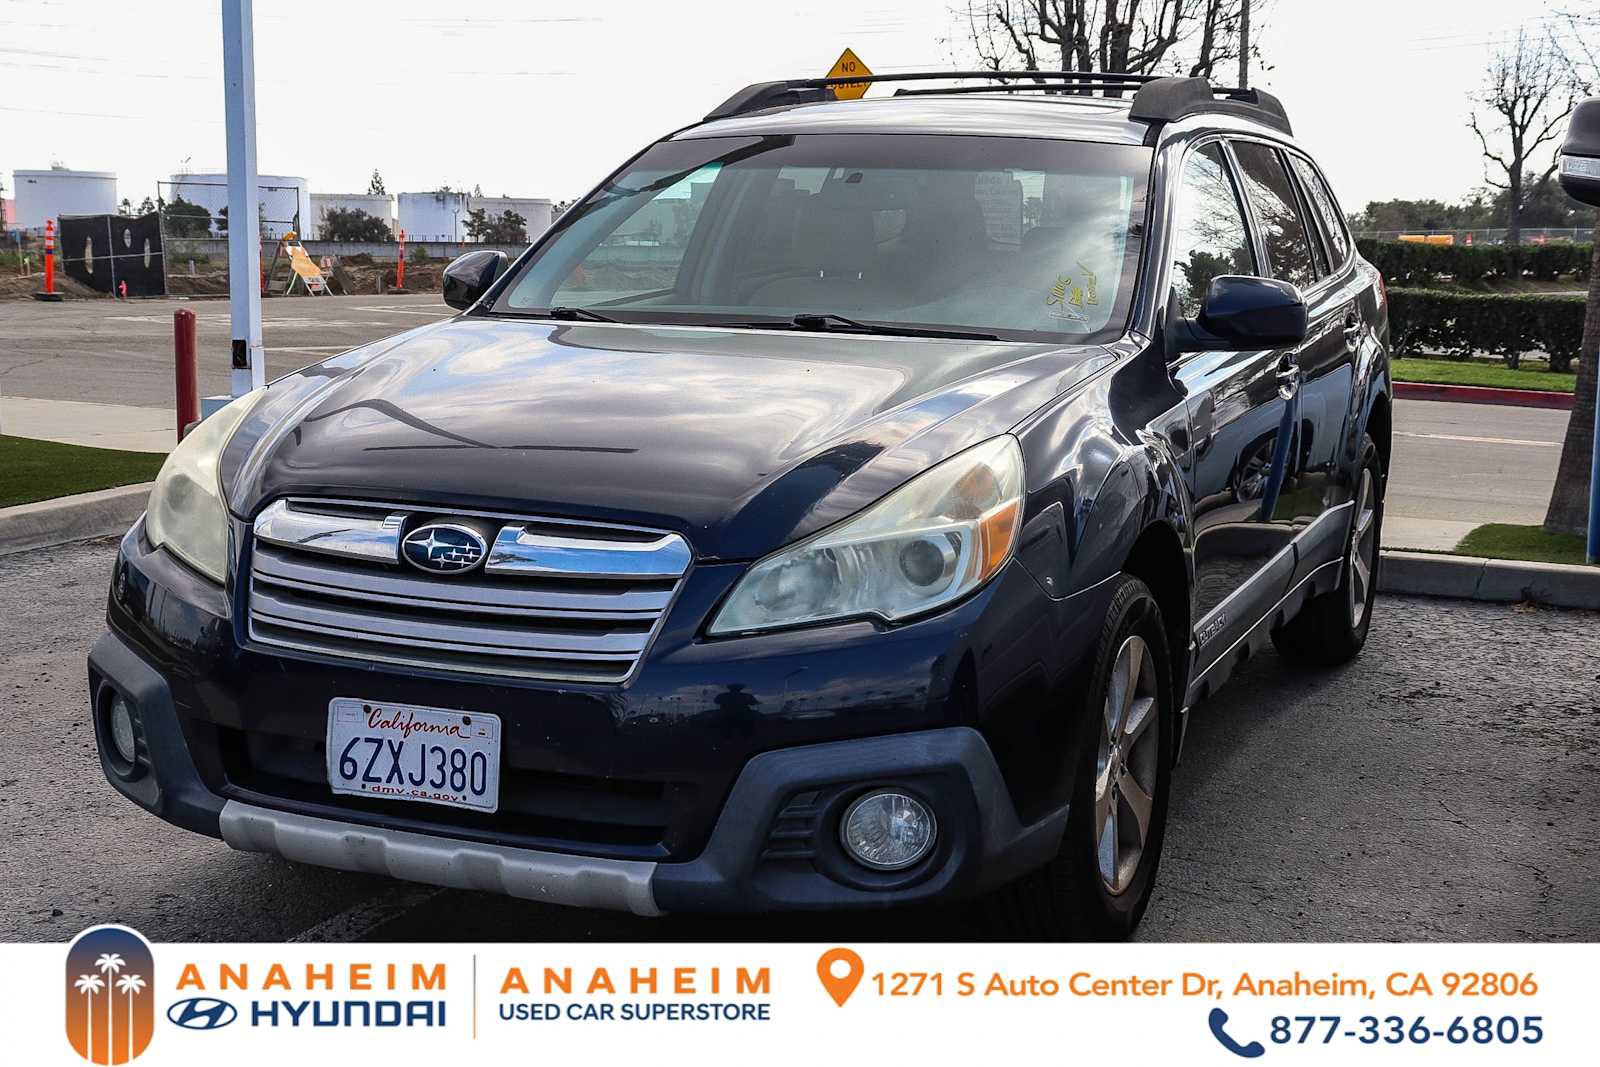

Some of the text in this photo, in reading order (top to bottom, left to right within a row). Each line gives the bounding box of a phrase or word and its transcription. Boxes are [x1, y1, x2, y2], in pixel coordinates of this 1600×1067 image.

[841, 61, 856, 73] NO
[367, 707, 471, 739] California
[339, 736, 487, 796] 6ZXJ380
[371, 785, 460, 802] dmv.ca.gov
